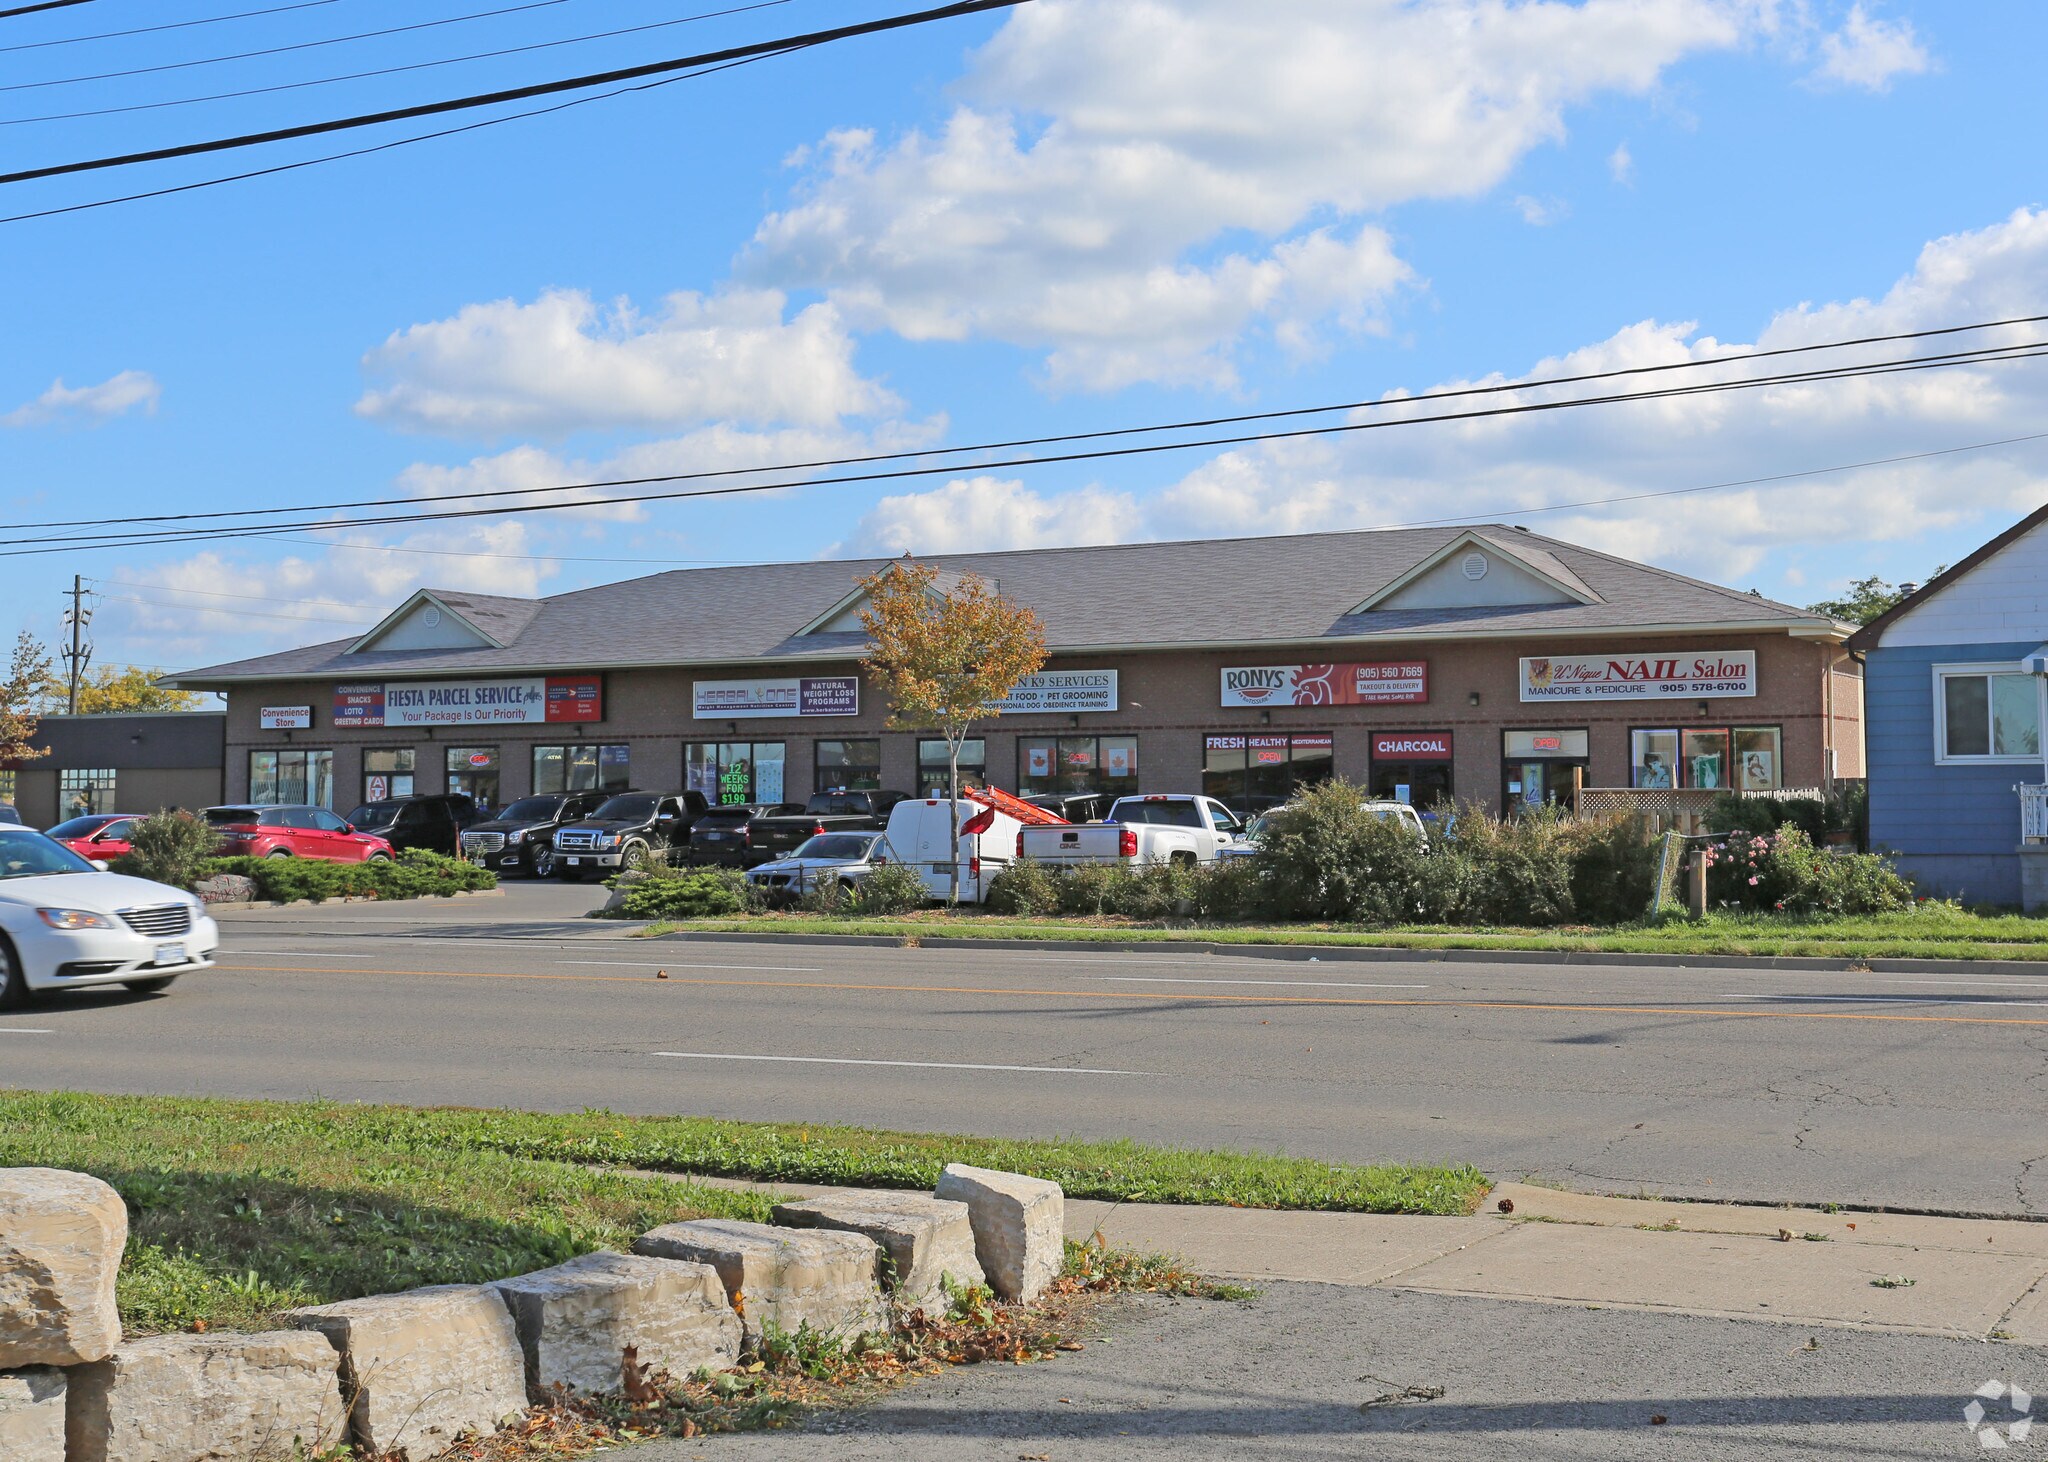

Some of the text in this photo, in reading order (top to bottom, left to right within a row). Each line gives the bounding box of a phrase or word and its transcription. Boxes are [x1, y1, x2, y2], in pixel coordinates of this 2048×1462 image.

[1357, 667, 1422, 679] (905) 560 7669
[1603, 660, 1687, 680] NAIL
[1692, 659, 1746, 678] Salon
[1032, 678, 1045, 688] K9
[1049, 676, 1108, 687] SERVICES
[1227, 670, 1285, 689] RONYS
[1529, 684, 1645, 695] MANICURE & PEDICURE
[1659, 683, 1746, 692] (905) 578-6700
[388, 690, 424, 706] FIESTA
[429, 688, 471, 705] PARCEL
[475, 686, 522, 704] SERVICE
[697, 688, 796, 703] HERBAL ONE
[1048, 692, 1060, 700] PET
[262, 708, 308, 717] Convenience
[402, 708, 526, 722] Your Package Is Our Priority
[1207, 738, 1244, 748] FRESH
[1249, 738, 1287, 746] HEALTHY
[1379, 741, 1446, 752] CHARCOAL
[1534, 738, 1560, 748] OPEN
[1069, 754, 1090, 762] OPEN
[1258, 752, 1280, 761] OPEN
[729, 764, 741, 773] 12
[721, 775, 748, 783] WEEKS
[726, 784, 743, 792] FOR
[722, 794, 745, 804] $199
